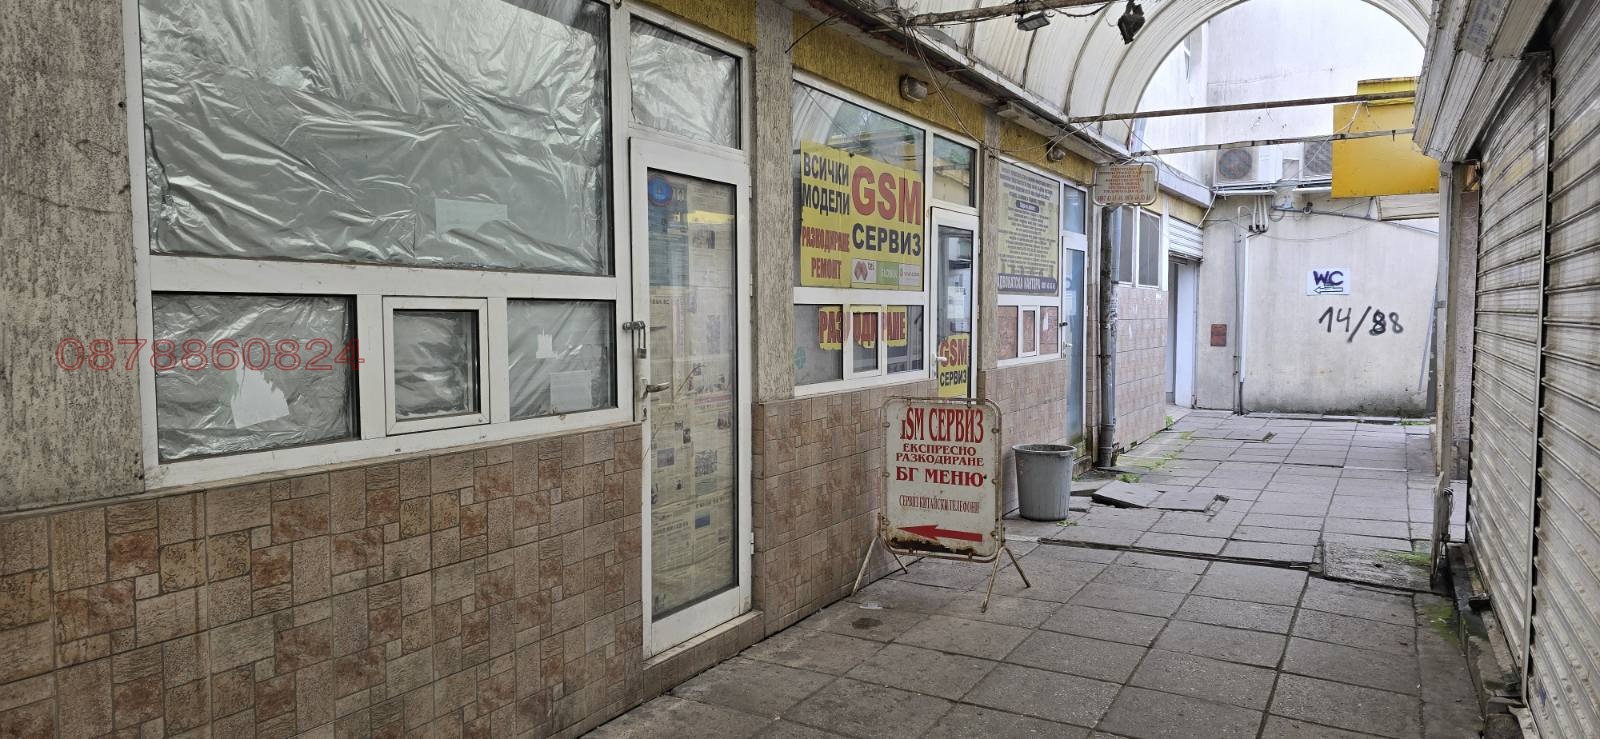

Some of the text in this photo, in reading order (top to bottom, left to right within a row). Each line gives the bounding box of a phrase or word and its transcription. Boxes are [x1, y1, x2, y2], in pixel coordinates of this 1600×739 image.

[803, 152, 849, 186] ВСИЧКИ
[801, 183, 850, 216] МОДЕЛИ
[852, 165, 922, 225] GSM
[852, 223, 921, 257] СЕРВИЗ
[811, 257, 842, 280] РЕМОНТ
[1313, 270, 1344, 286] WC
[1318, 305, 1404, 343] 14/88
[939, 338, 968, 367] GSM
[940, 368, 967, 387] СЕРВИЗ
[928, 407, 984, 444] СЕРВИЗ
[896, 453, 984, 467] РАЗКОДИРАНЕ
[903, 443, 977, 457] ЕКСПРЕСНО
[896, 466, 984, 487] БГ МЕНЮ
